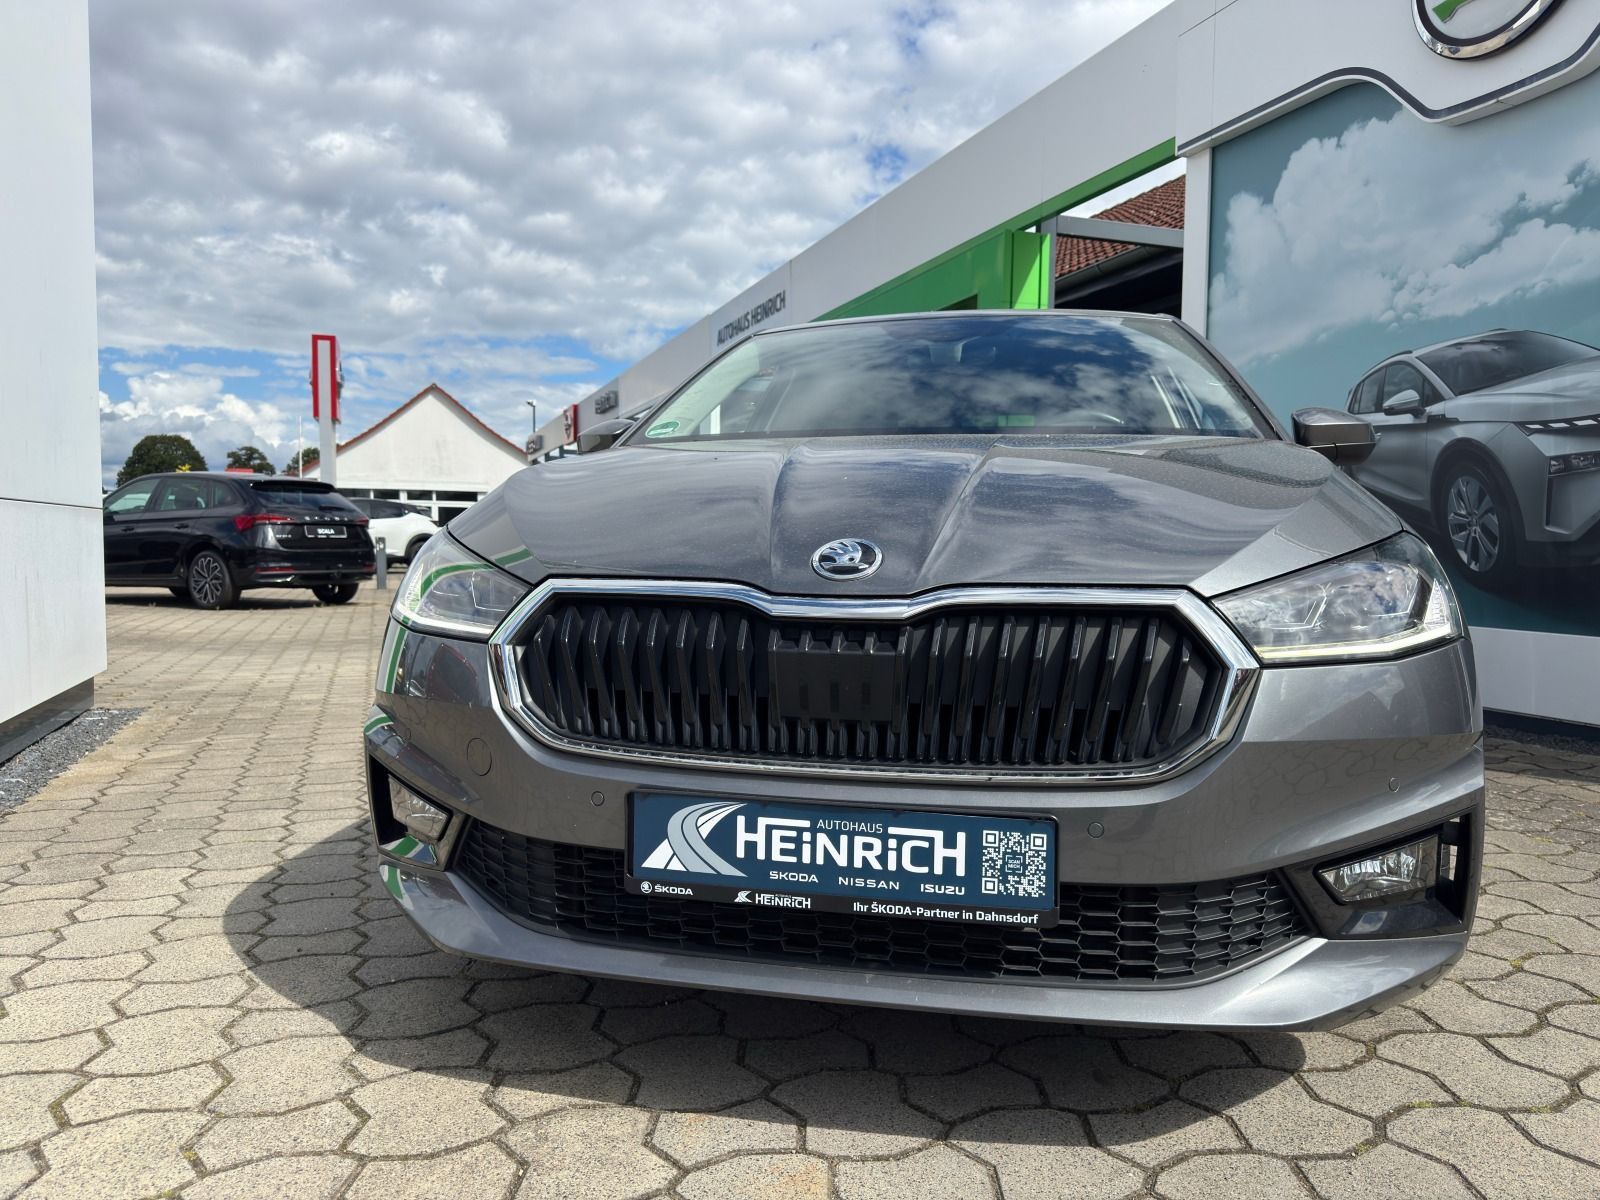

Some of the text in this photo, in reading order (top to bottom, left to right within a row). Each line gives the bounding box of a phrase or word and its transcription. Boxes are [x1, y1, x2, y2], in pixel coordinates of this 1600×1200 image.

[717, 290, 786, 346] AUTOHAUS HEINRICH
[816, 819, 883, 834] AUTOHAUS
[654, 884, 694, 896] ŠKODA
[838, 876, 900, 890] NISSAN
[920, 883, 965, 896] ISUZU
[853, 901, 1039, 924] Ihr ŠKODA-Partner in Dahnsdorf
